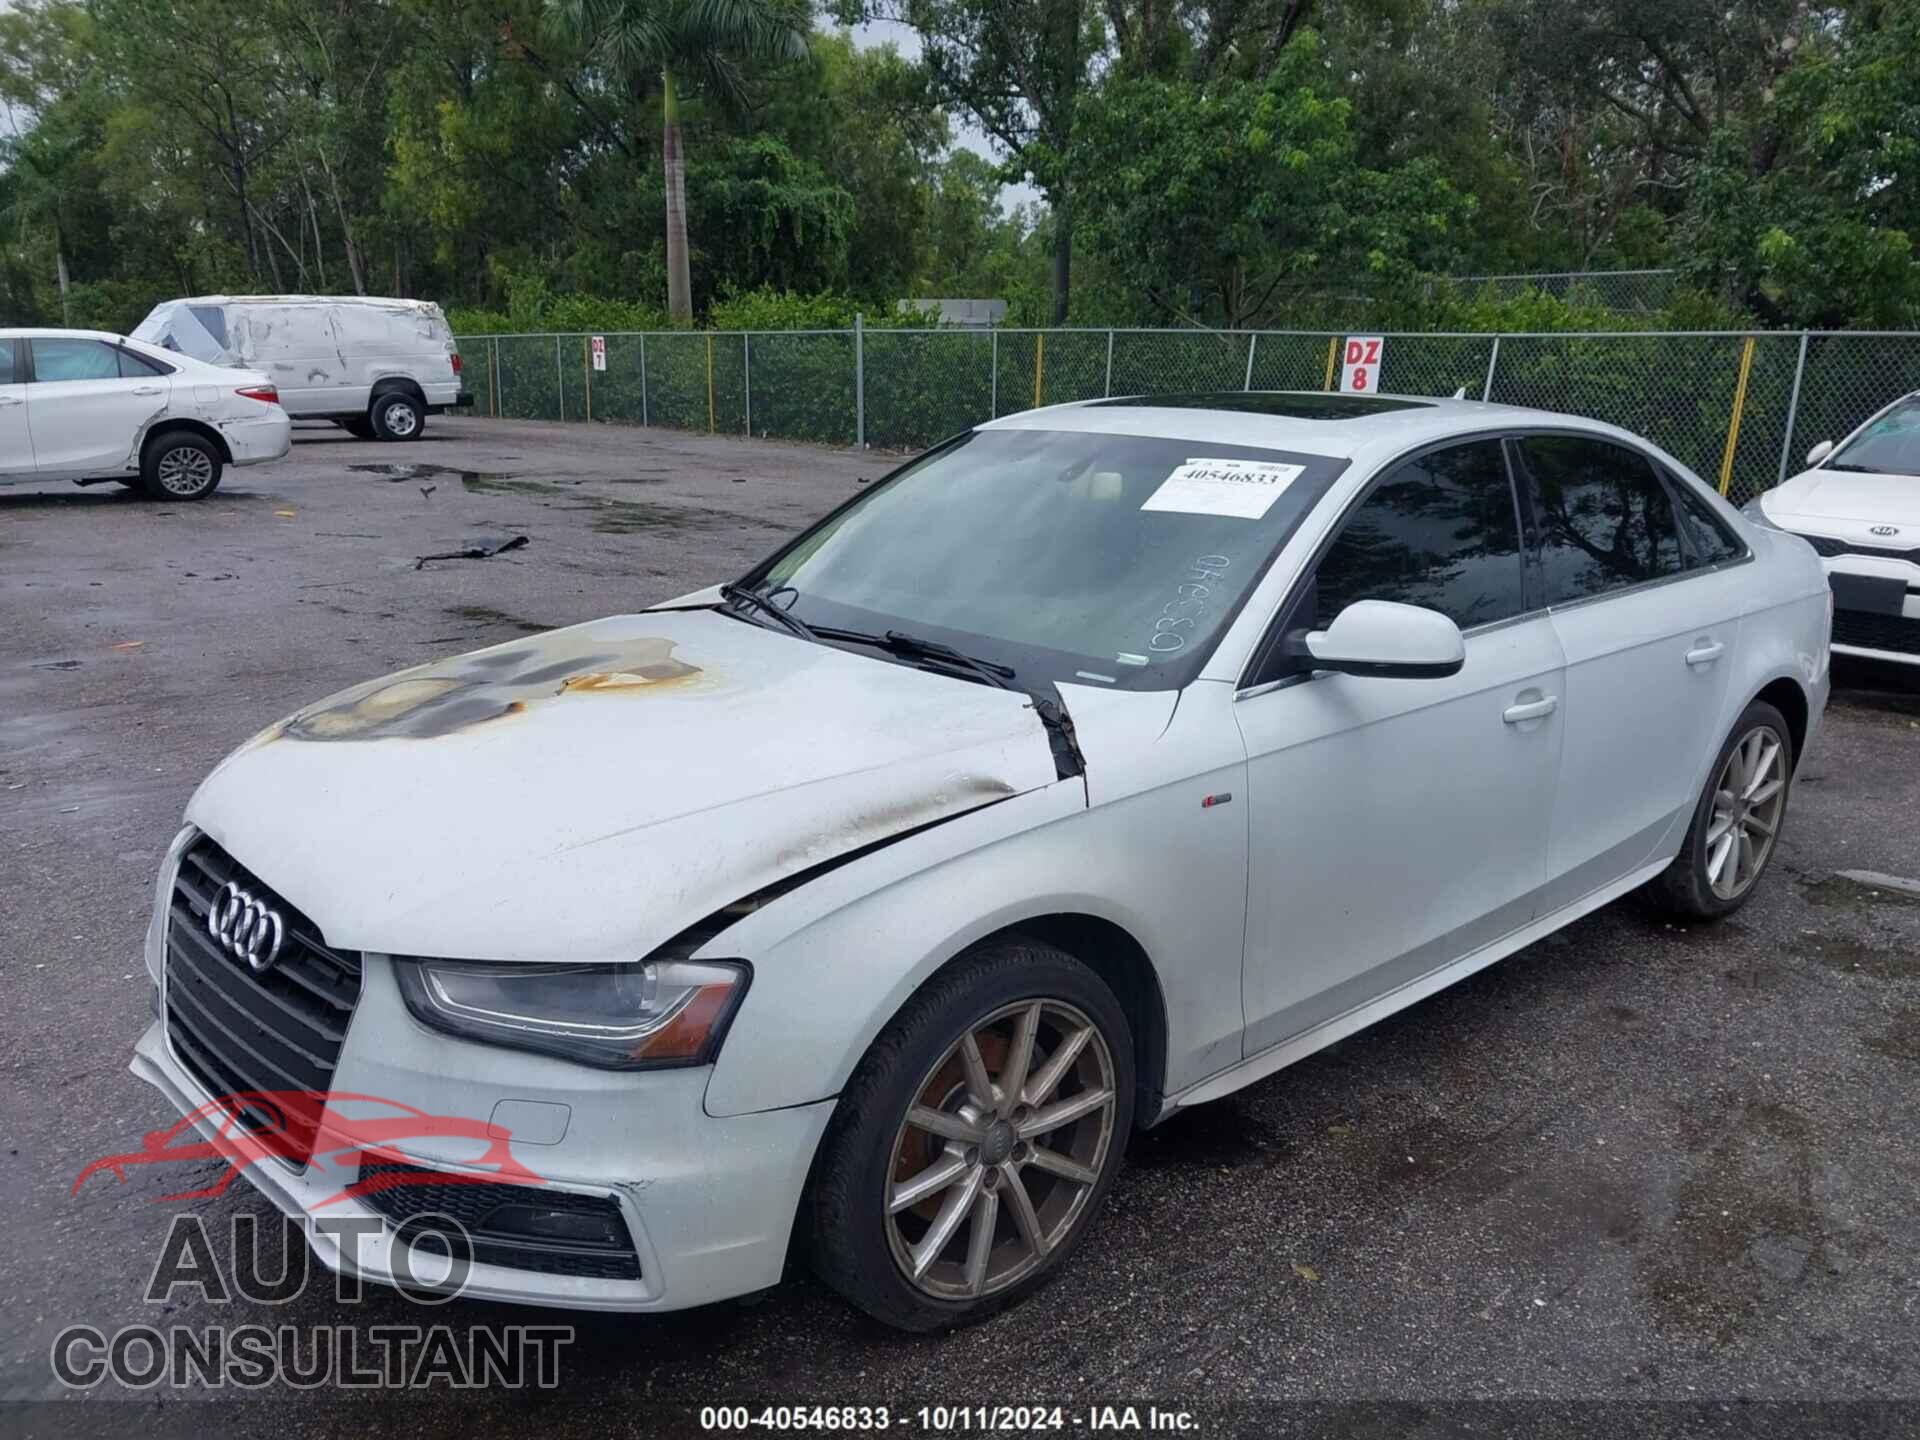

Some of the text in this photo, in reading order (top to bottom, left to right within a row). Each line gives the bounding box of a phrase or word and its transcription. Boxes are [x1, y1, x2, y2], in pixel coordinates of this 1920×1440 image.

[1346, 341, 1380, 365] DZ
[1352, 367, 1367, 391] 8
[1183, 469, 1280, 486] 40546833
